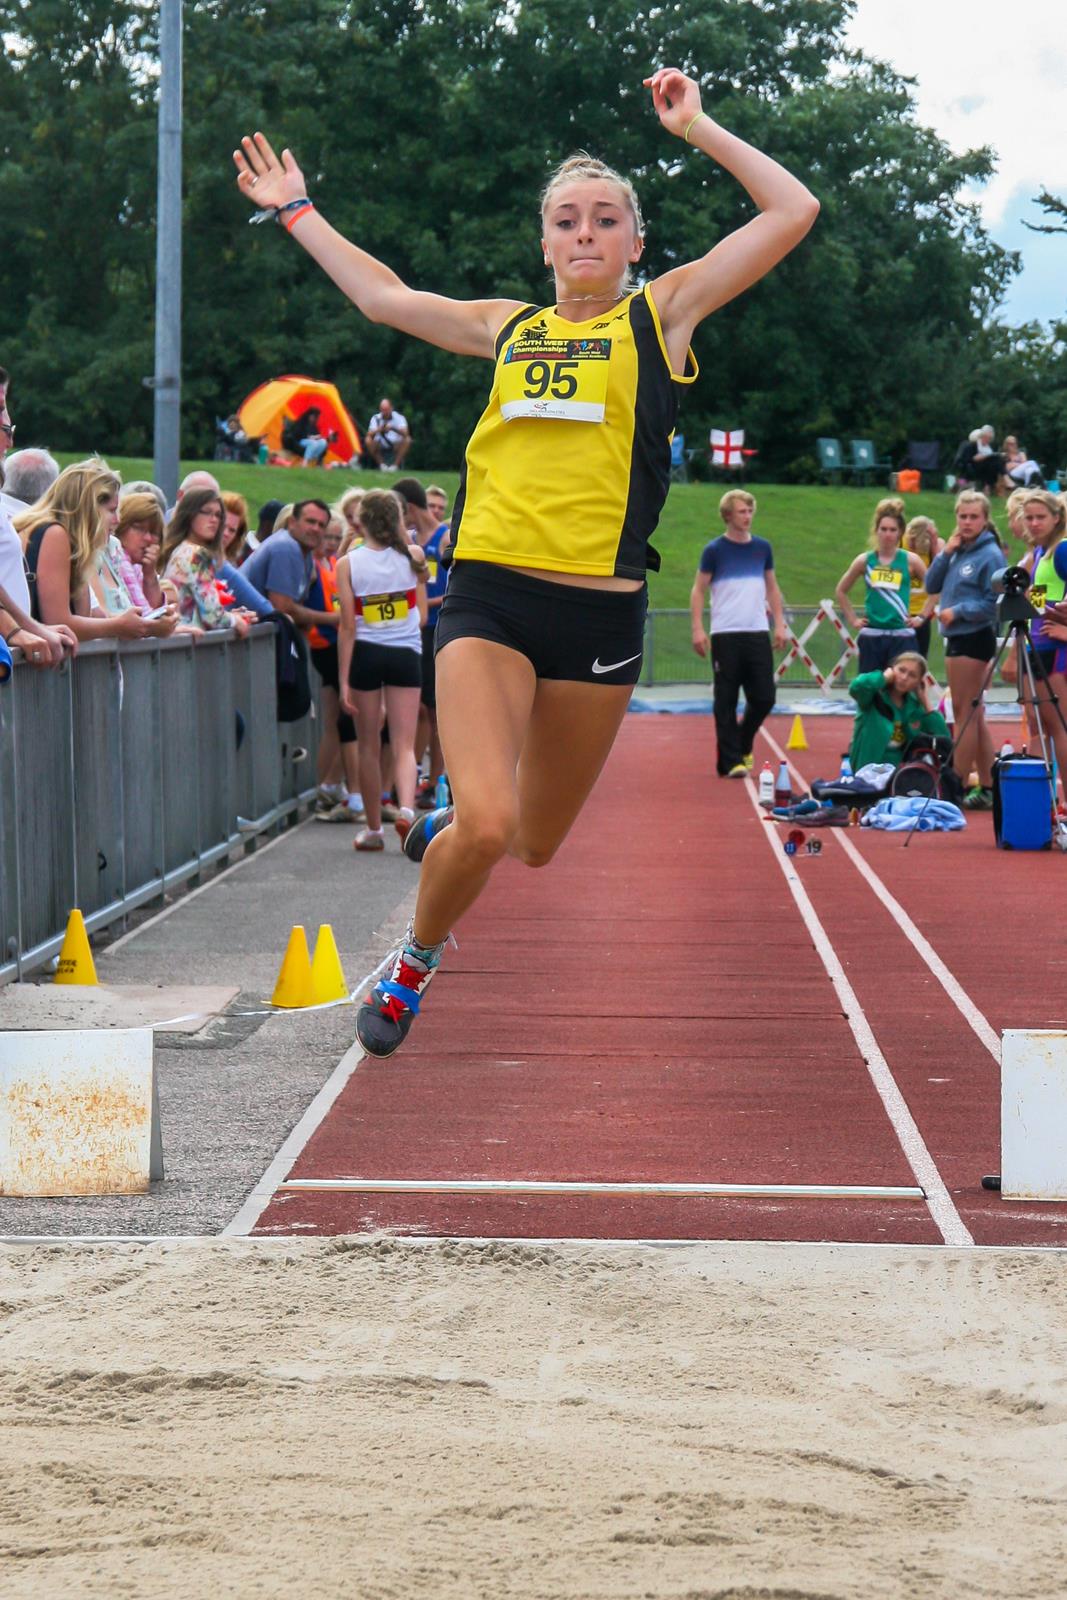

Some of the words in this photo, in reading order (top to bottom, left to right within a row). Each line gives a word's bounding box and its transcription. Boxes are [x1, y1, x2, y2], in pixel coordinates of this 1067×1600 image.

[513, 340, 542, 348] SOUTH
[513, 346, 568, 354] Championships
[523, 361, 579, 400] 95
[878, 571, 895, 583] 119
[377, 602, 395, 620] 19
[806, 839, 823, 854] 19
